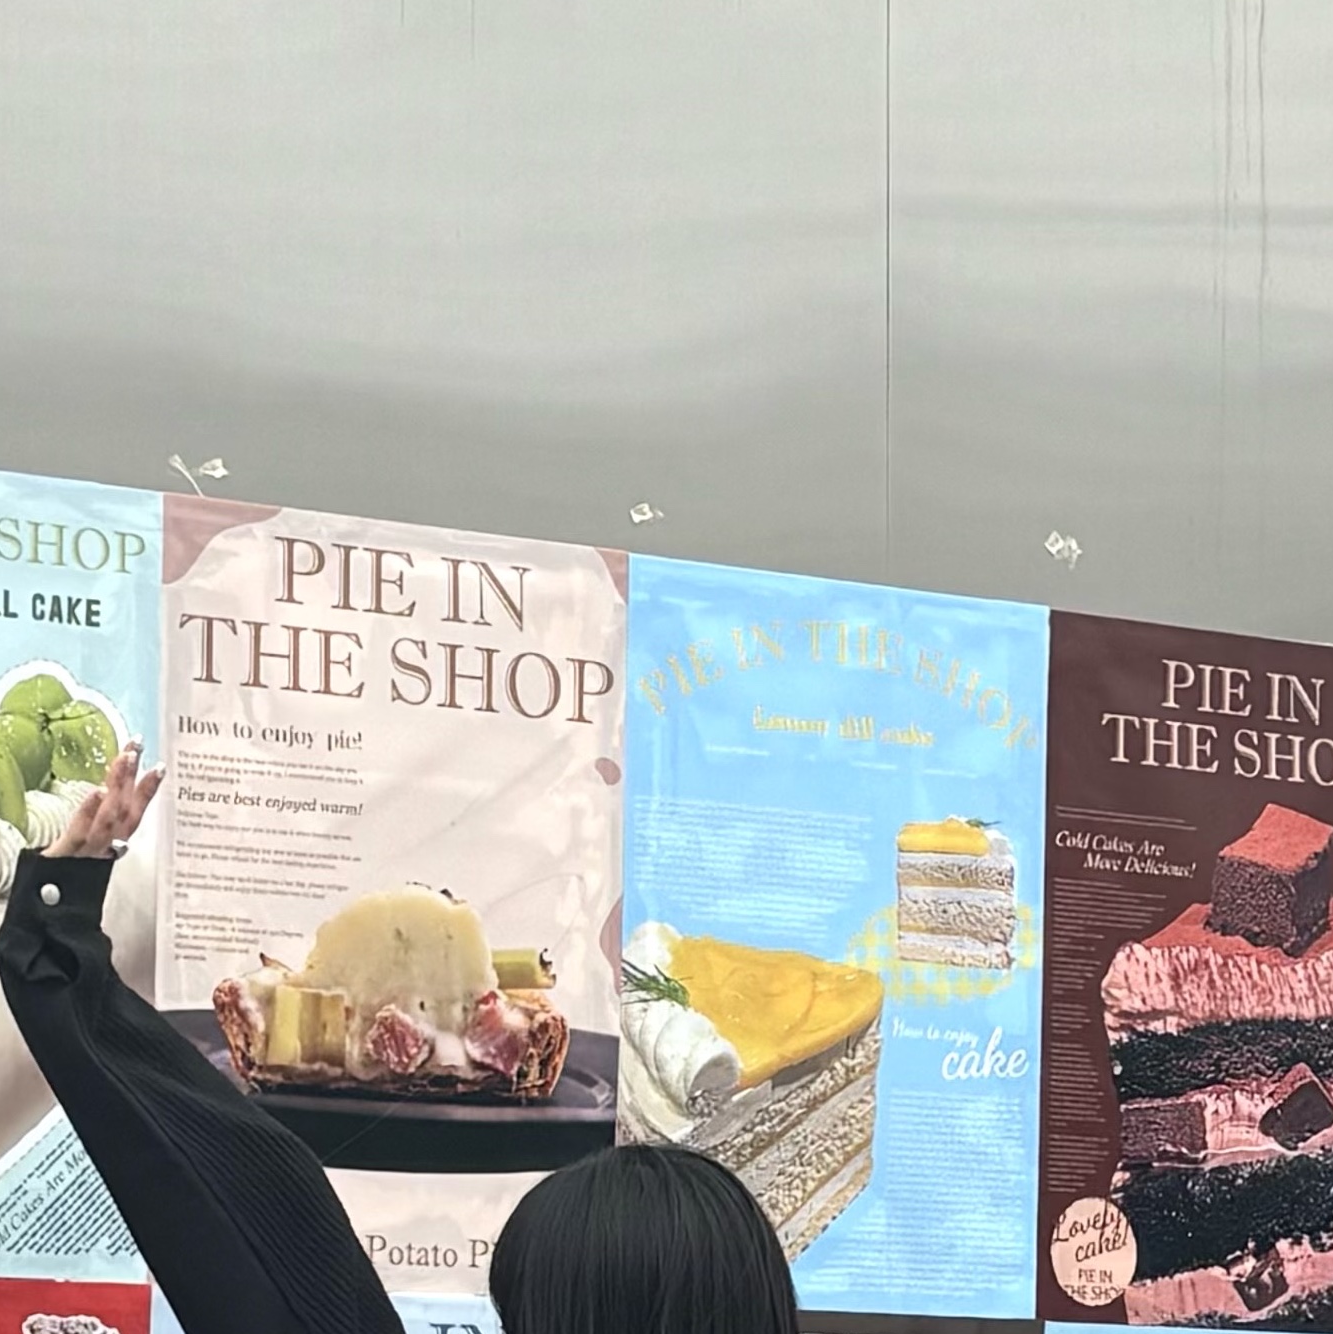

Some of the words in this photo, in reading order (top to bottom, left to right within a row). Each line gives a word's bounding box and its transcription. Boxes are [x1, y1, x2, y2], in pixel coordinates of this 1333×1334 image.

[274, 535, 417, 619] PIE
[440, 555, 531, 633] IN
[30, 591, 103, 628] CAKE
[178, 612, 365, 699] THE
[390, 635, 615, 725] SHOP
[638, 638, 724, 716] PIE
[730, 622, 787, 671] IN
[800, 619, 905, 674] THE
[913, 647, 1037, 750] SHOP
[1161, 658, 1253, 718] PIE
[1265, 671, 1325, 726] IN
[177, 715, 220, 736] How
[233, 721, 252, 739] to
[261, 725, 315, 750] enjoy
[327, 730, 363, 752] pie!
[1101, 712, 1219, 774] THE
[177, 787, 206, 802] Pies
[207, 792, 230, 804] are
[233, 791, 261, 807] best
[265, 797, 317, 814] enjoyed
[320, 802, 363, 816] warm!
[1055, 830, 1091, 849] Cold
[1137, 840, 1165, 856] Are
[1083, 852, 1122, 871] More
[1124, 856, 1197, 878] Delicious!
[941, 1025, 1029, 1080] cake
[64, 1150, 86, 1174] Mo
[1053, 1200, 1123, 1243] Lovely
[364, 1234, 459, 1268] Potato
